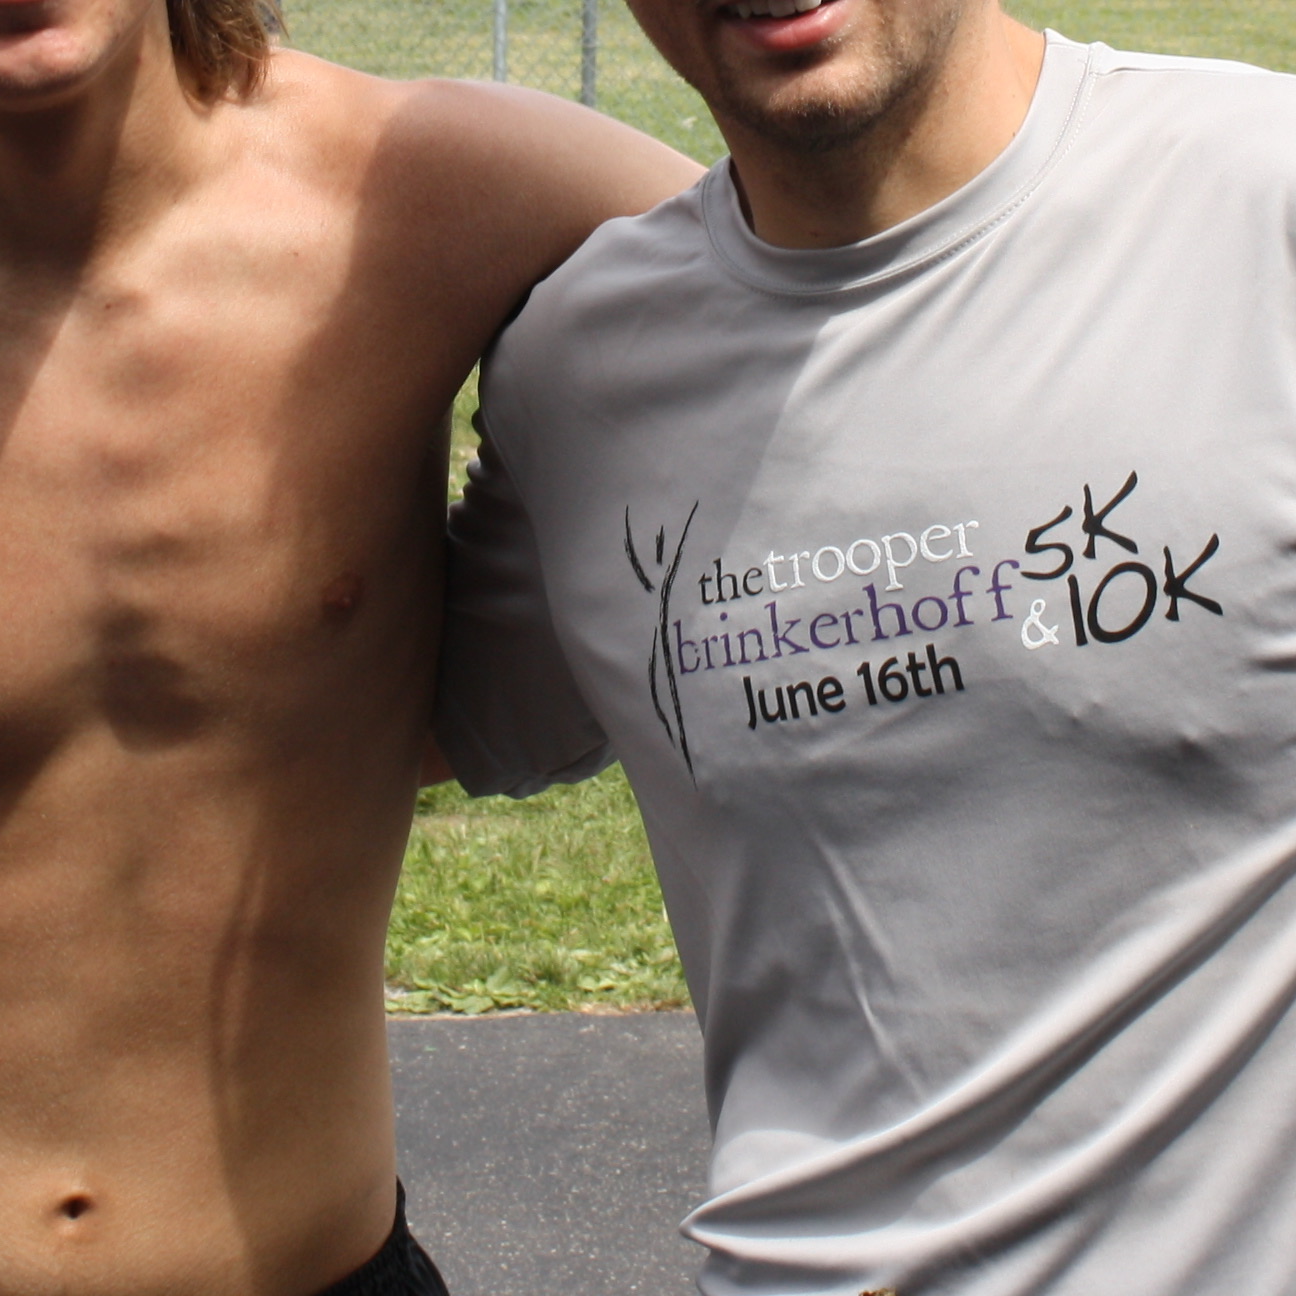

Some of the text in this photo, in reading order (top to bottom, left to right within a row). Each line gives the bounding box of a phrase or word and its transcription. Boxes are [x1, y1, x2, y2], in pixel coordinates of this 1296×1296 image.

[1020, 470, 1138, 580] 5K
[673, 560, 1020, 675] brinkerhoff
[1021, 533, 1223, 649] & 10K
[742, 643, 965, 730] June 16th
